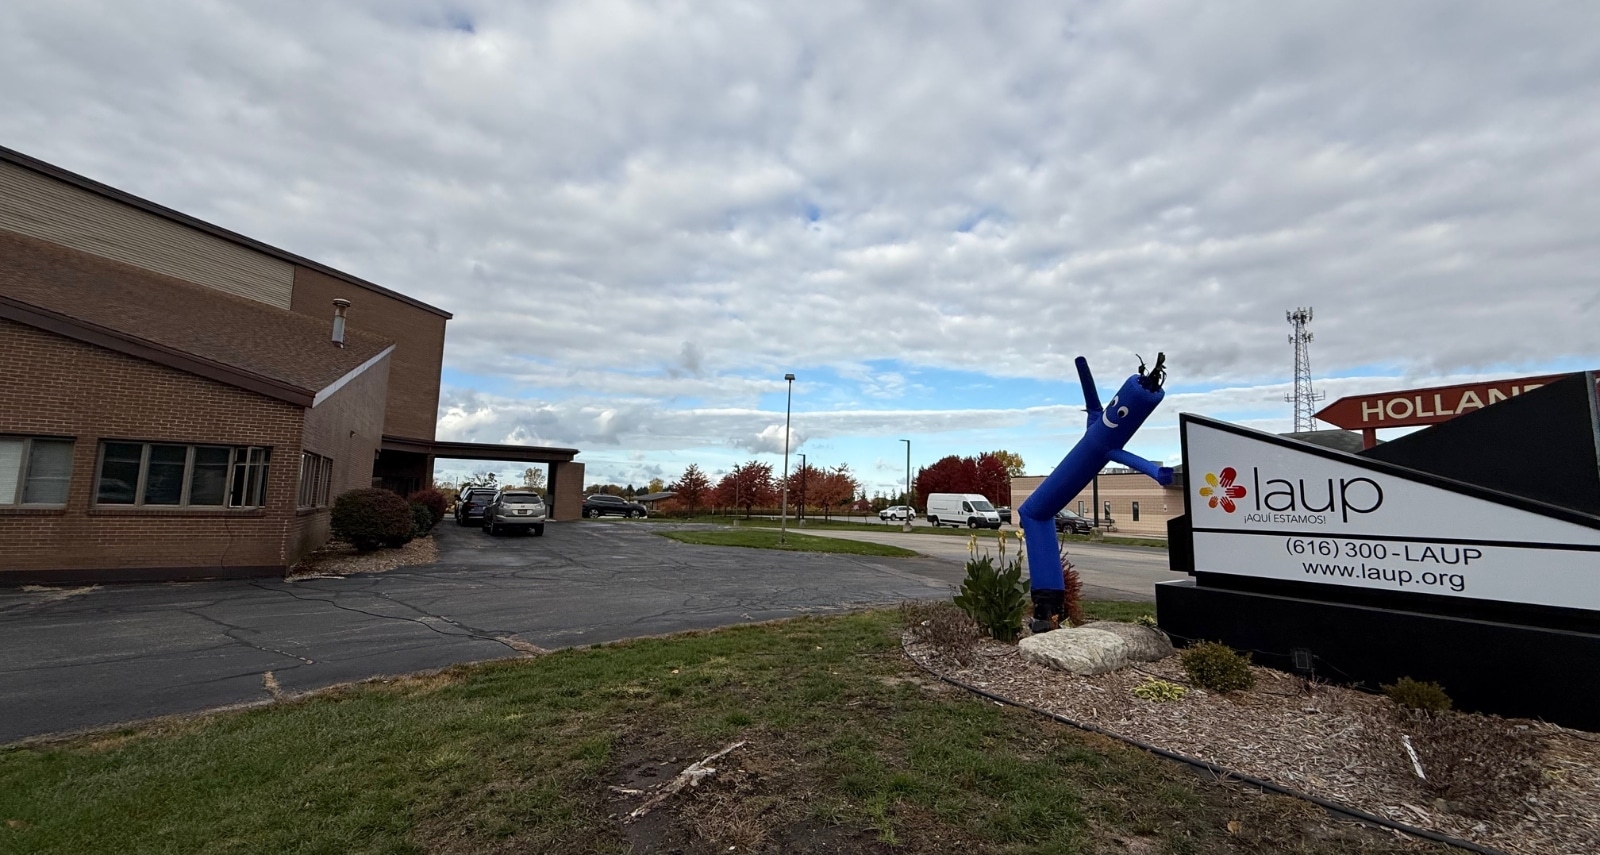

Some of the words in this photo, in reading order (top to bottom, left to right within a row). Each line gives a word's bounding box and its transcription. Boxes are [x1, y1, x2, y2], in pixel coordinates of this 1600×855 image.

[1361, 383, 1545, 422] HOLLAN
[1253, 466, 1384, 524] laup
[1244, 512, 1271, 524] ¡AQUÍ
[1273, 513, 1326, 525] ESTAMOS!
[1286, 537, 1340, 559] (616)
[1301, 562, 1466, 593] www.laup.org
